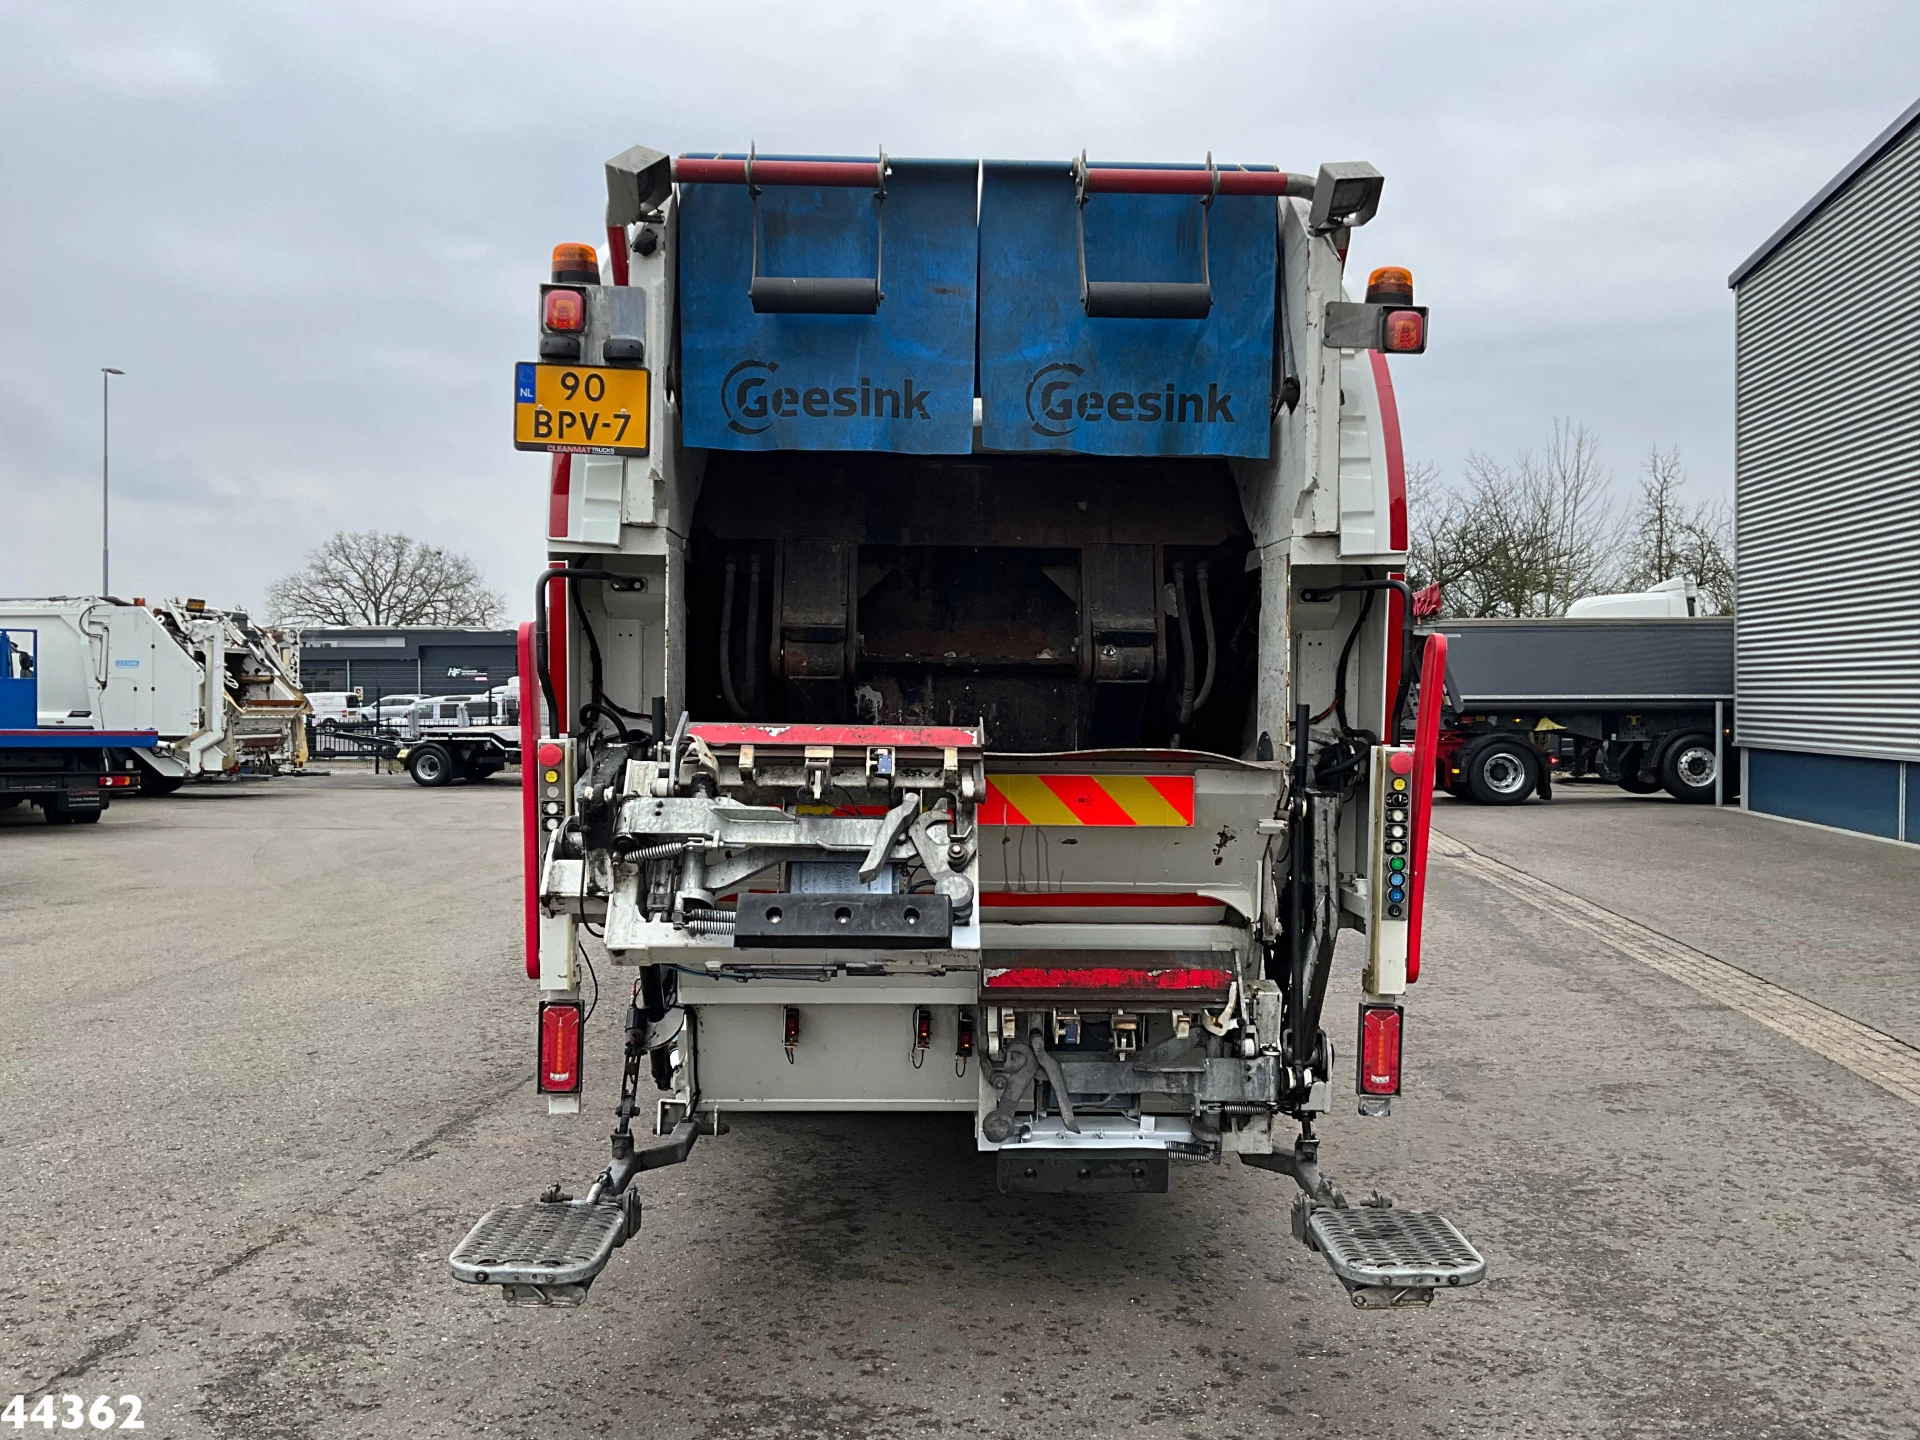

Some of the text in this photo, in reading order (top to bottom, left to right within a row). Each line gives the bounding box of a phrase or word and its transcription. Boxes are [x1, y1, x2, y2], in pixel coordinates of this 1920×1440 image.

[520, 388, 534, 398] NL
[560, 371, 605, 402] 90
[736, 377, 932, 421] Geesink
[1041, 381, 1235, 424] Geesink
[534, 409, 631, 442] BPV-7
[546, 444, 591, 454] CLEANMAT
